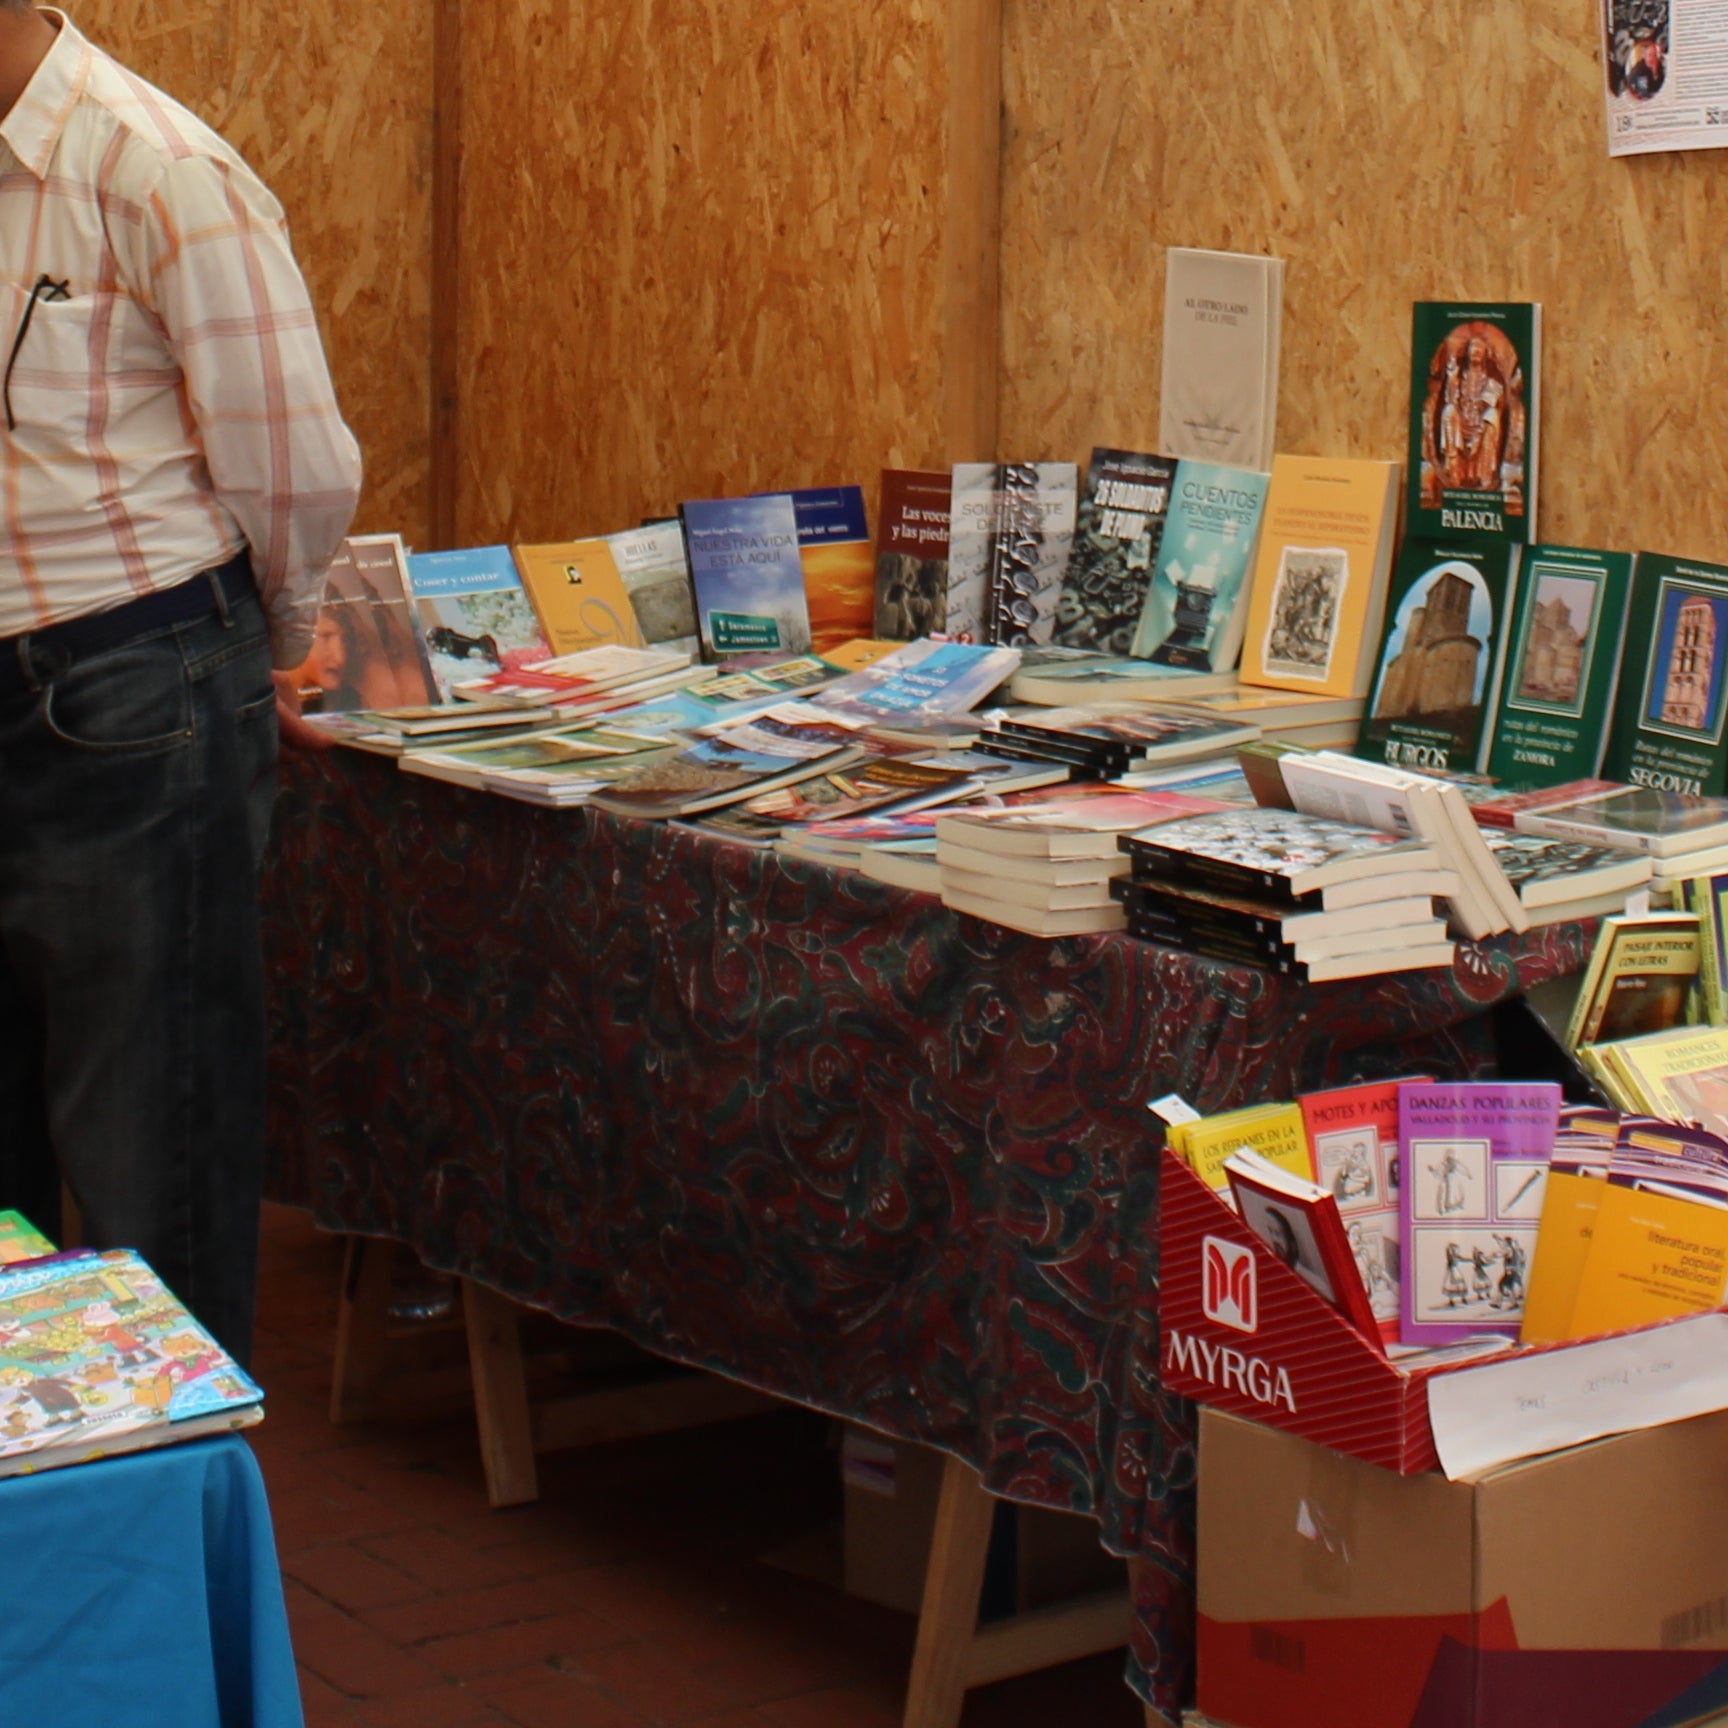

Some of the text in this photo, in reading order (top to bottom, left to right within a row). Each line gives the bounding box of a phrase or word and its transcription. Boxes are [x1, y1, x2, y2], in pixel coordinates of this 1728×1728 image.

[1182, 481, 1258, 509] CUENTOS
[902, 505, 920, 519] Las
[1180, 501, 1252, 524] PENDIENTES
[1441, 508, 1504, 532] PALENCIA
[694, 534, 793, 552] NUESTRA VIDA
[891, 523, 950, 543] y las piedr
[460, 570, 500, 585] contar
[1627, 766, 1702, 798] SEGOVIA
[1312, 1096, 1398, 1125] MOTES Y APO
[1408, 1095, 1552, 1112] DANZAS POPULARES
[1202, 1139, 1221, 1156] LOS
[1267, 1129, 1282, 1146] EN
[1282, 1125, 1296, 1141] LA
[1260, 1140, 1299, 1164] OPULAR
[1648, 1230, 1701, 1254] literatura
[1651, 1263, 1721, 1287] y tradicional
[1680, 1254, 1724, 1273] popular
[1167, 1329, 1297, 1414] MYRGA
